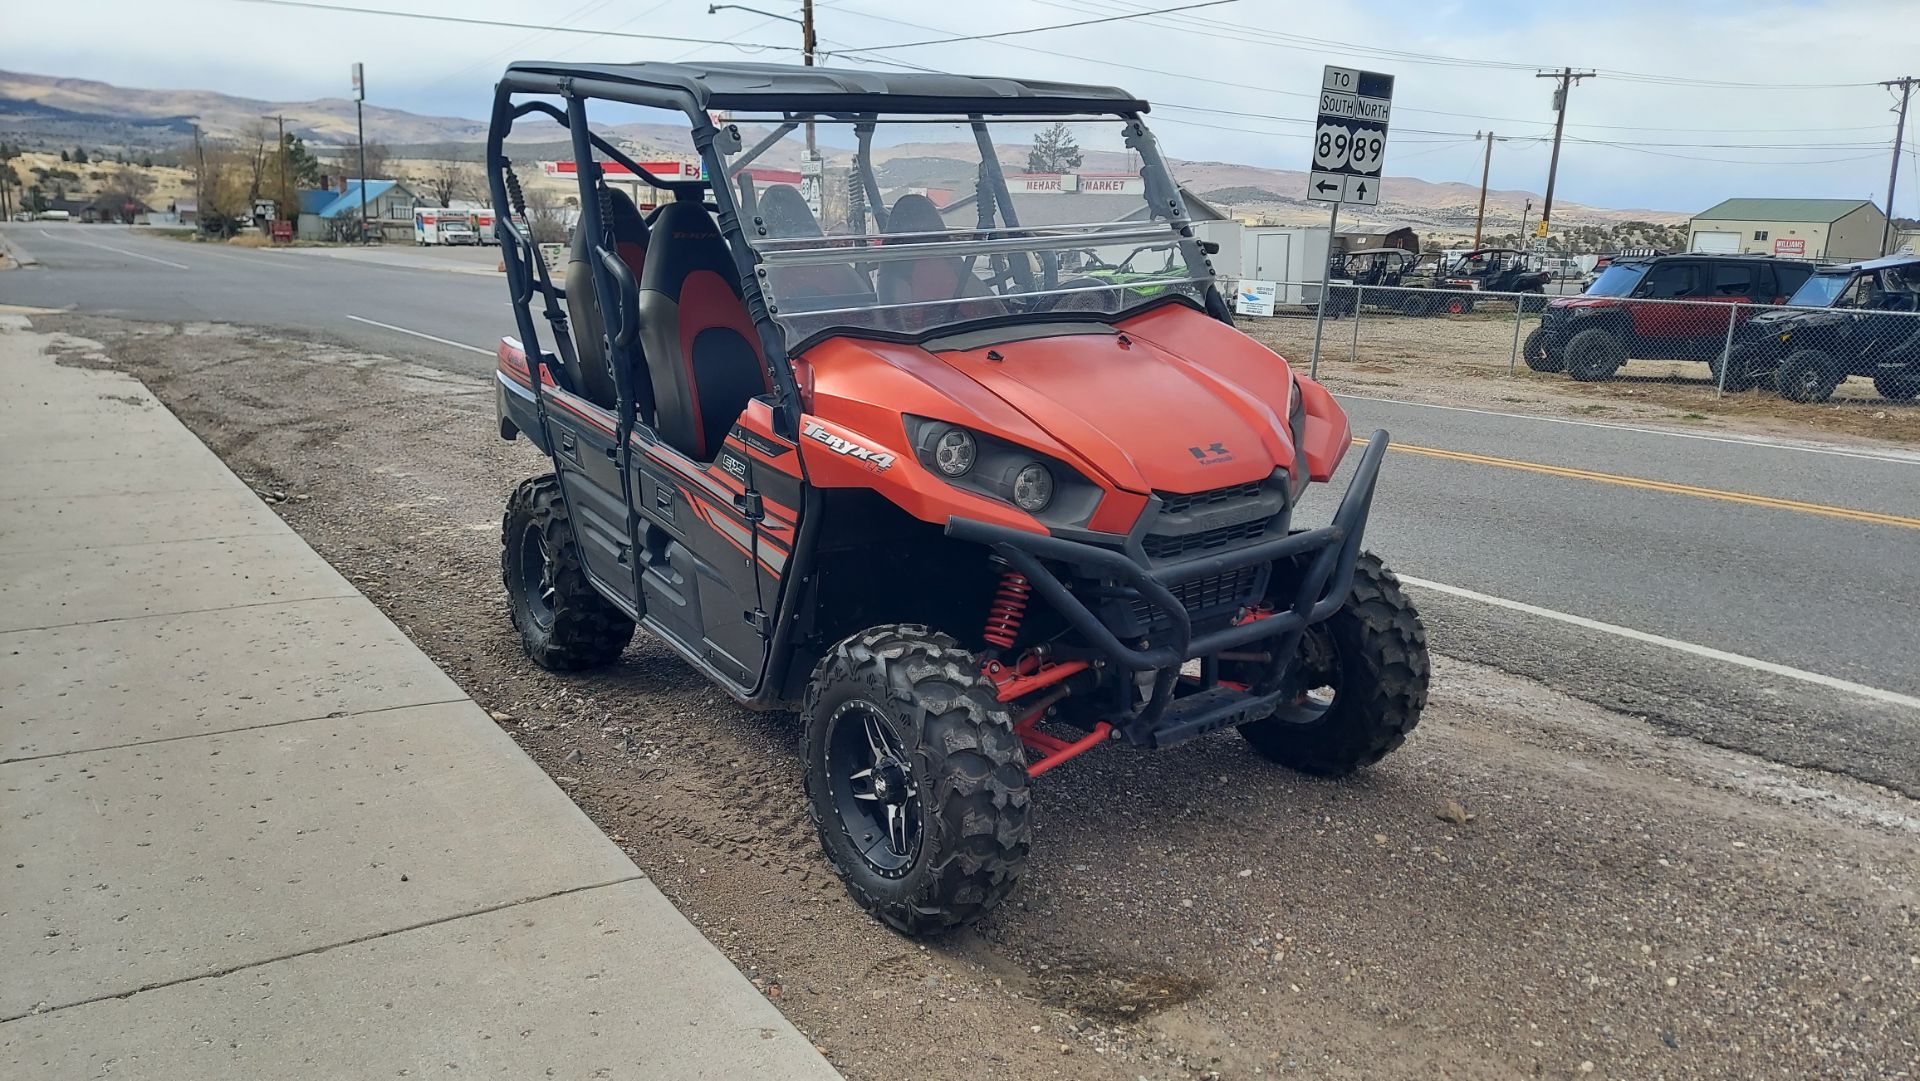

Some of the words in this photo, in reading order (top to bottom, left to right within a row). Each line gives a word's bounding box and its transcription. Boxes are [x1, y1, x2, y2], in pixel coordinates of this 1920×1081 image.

[1333, 72, 1350, 87] TO
[1321, 95, 1354, 115] SOUTH
[1357, 100, 1389, 119] NORTH
[1319, 132, 1347, 159] 89
[1353, 137, 1382, 163] 89
[1085, 181, 1125, 191] MARKET
[802, 421, 896, 470] TERYX4
